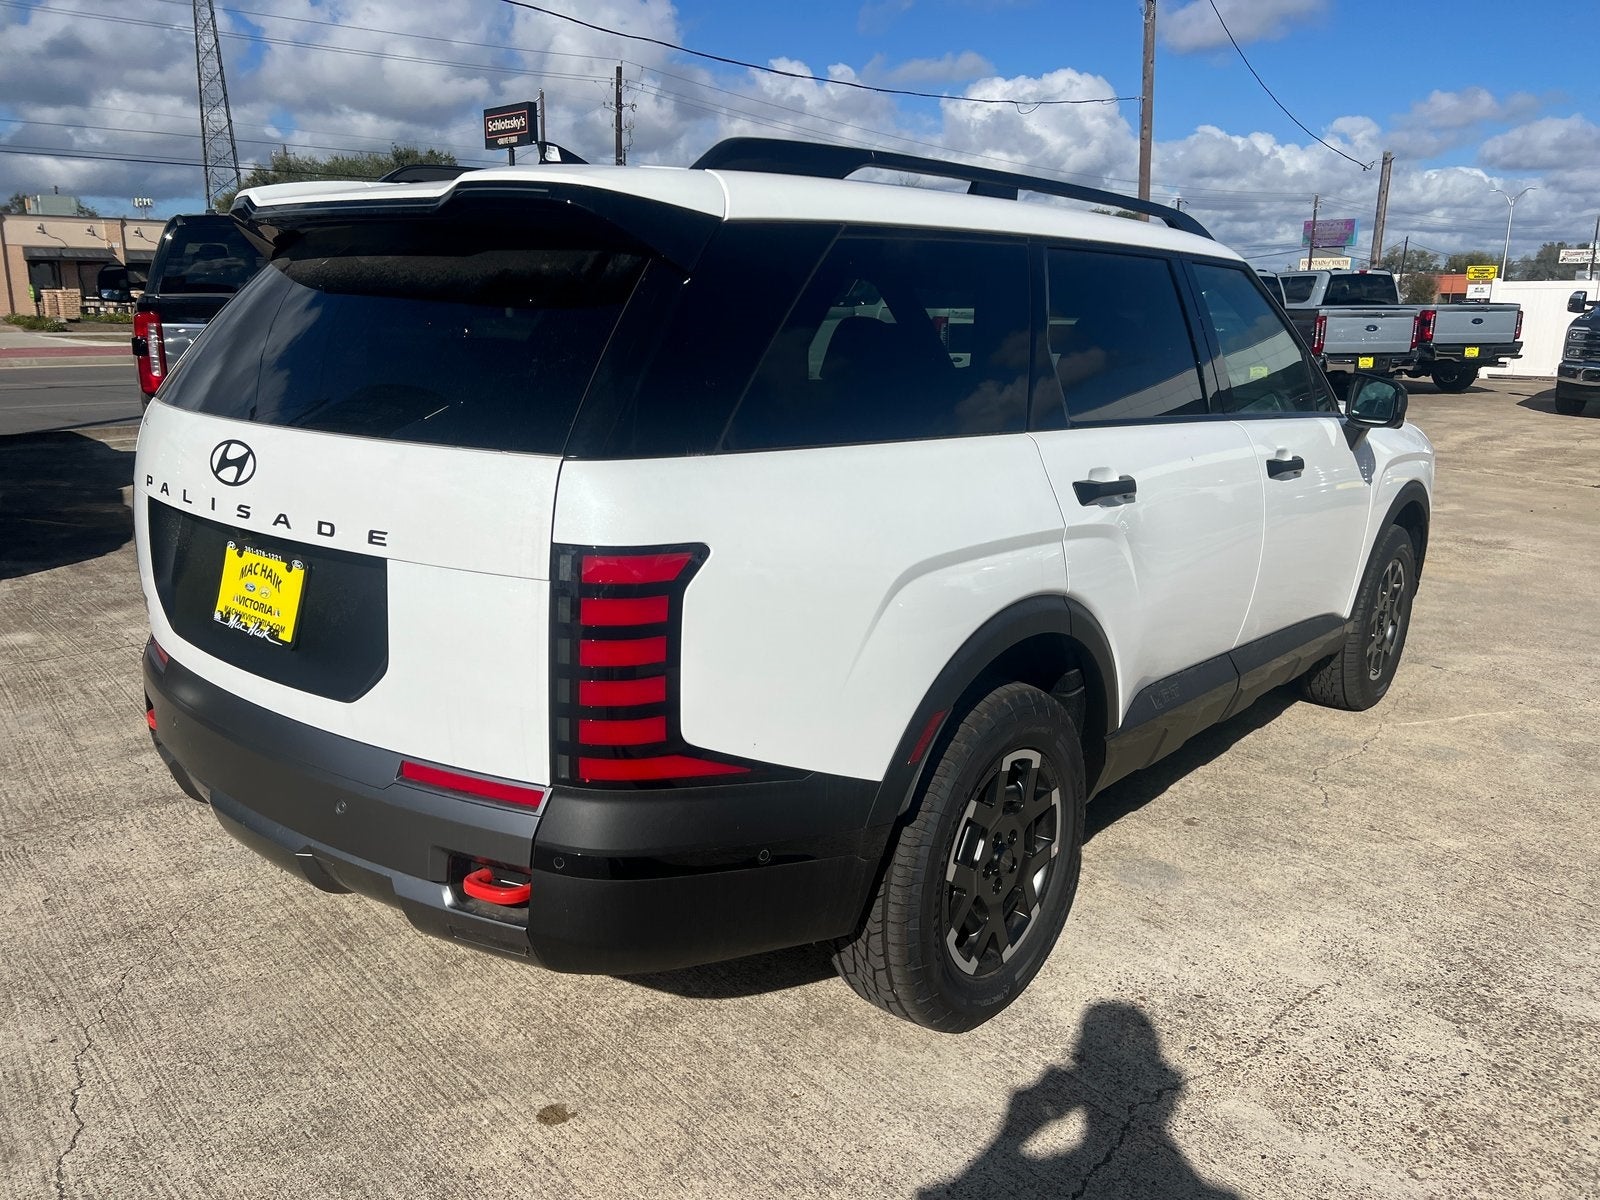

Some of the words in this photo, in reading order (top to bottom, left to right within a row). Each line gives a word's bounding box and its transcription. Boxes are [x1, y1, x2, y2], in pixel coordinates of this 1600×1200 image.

[488, 116, 525, 131] Schlotzsky's
[146, 474, 389, 547] PALISADE
[240, 562, 261, 580] MAC
[260, 563, 283, 594] HAIK
[238, 594, 273, 617] VICTORIA
[224, 613, 248, 632] Mac
